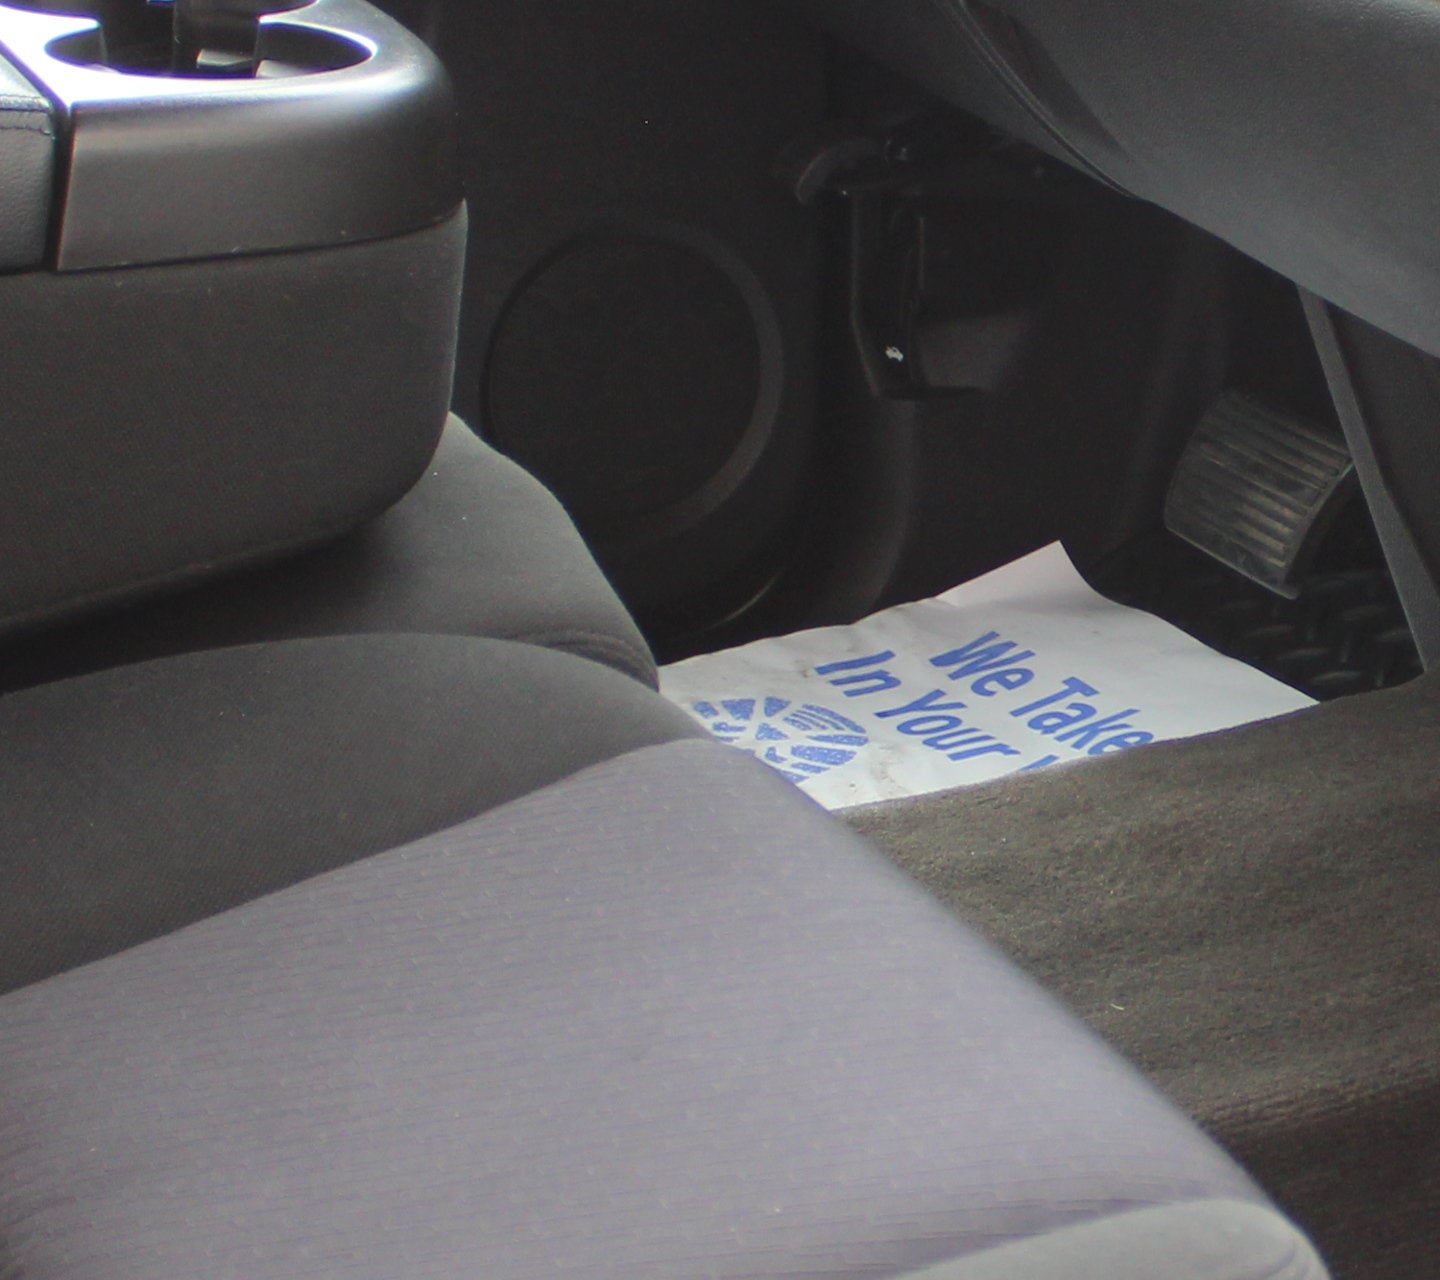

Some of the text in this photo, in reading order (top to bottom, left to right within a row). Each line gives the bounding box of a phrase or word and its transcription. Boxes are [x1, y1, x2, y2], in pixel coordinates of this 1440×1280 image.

[814, 649, 1021, 762] In Your
[929, 631, 1154, 755] We Take
